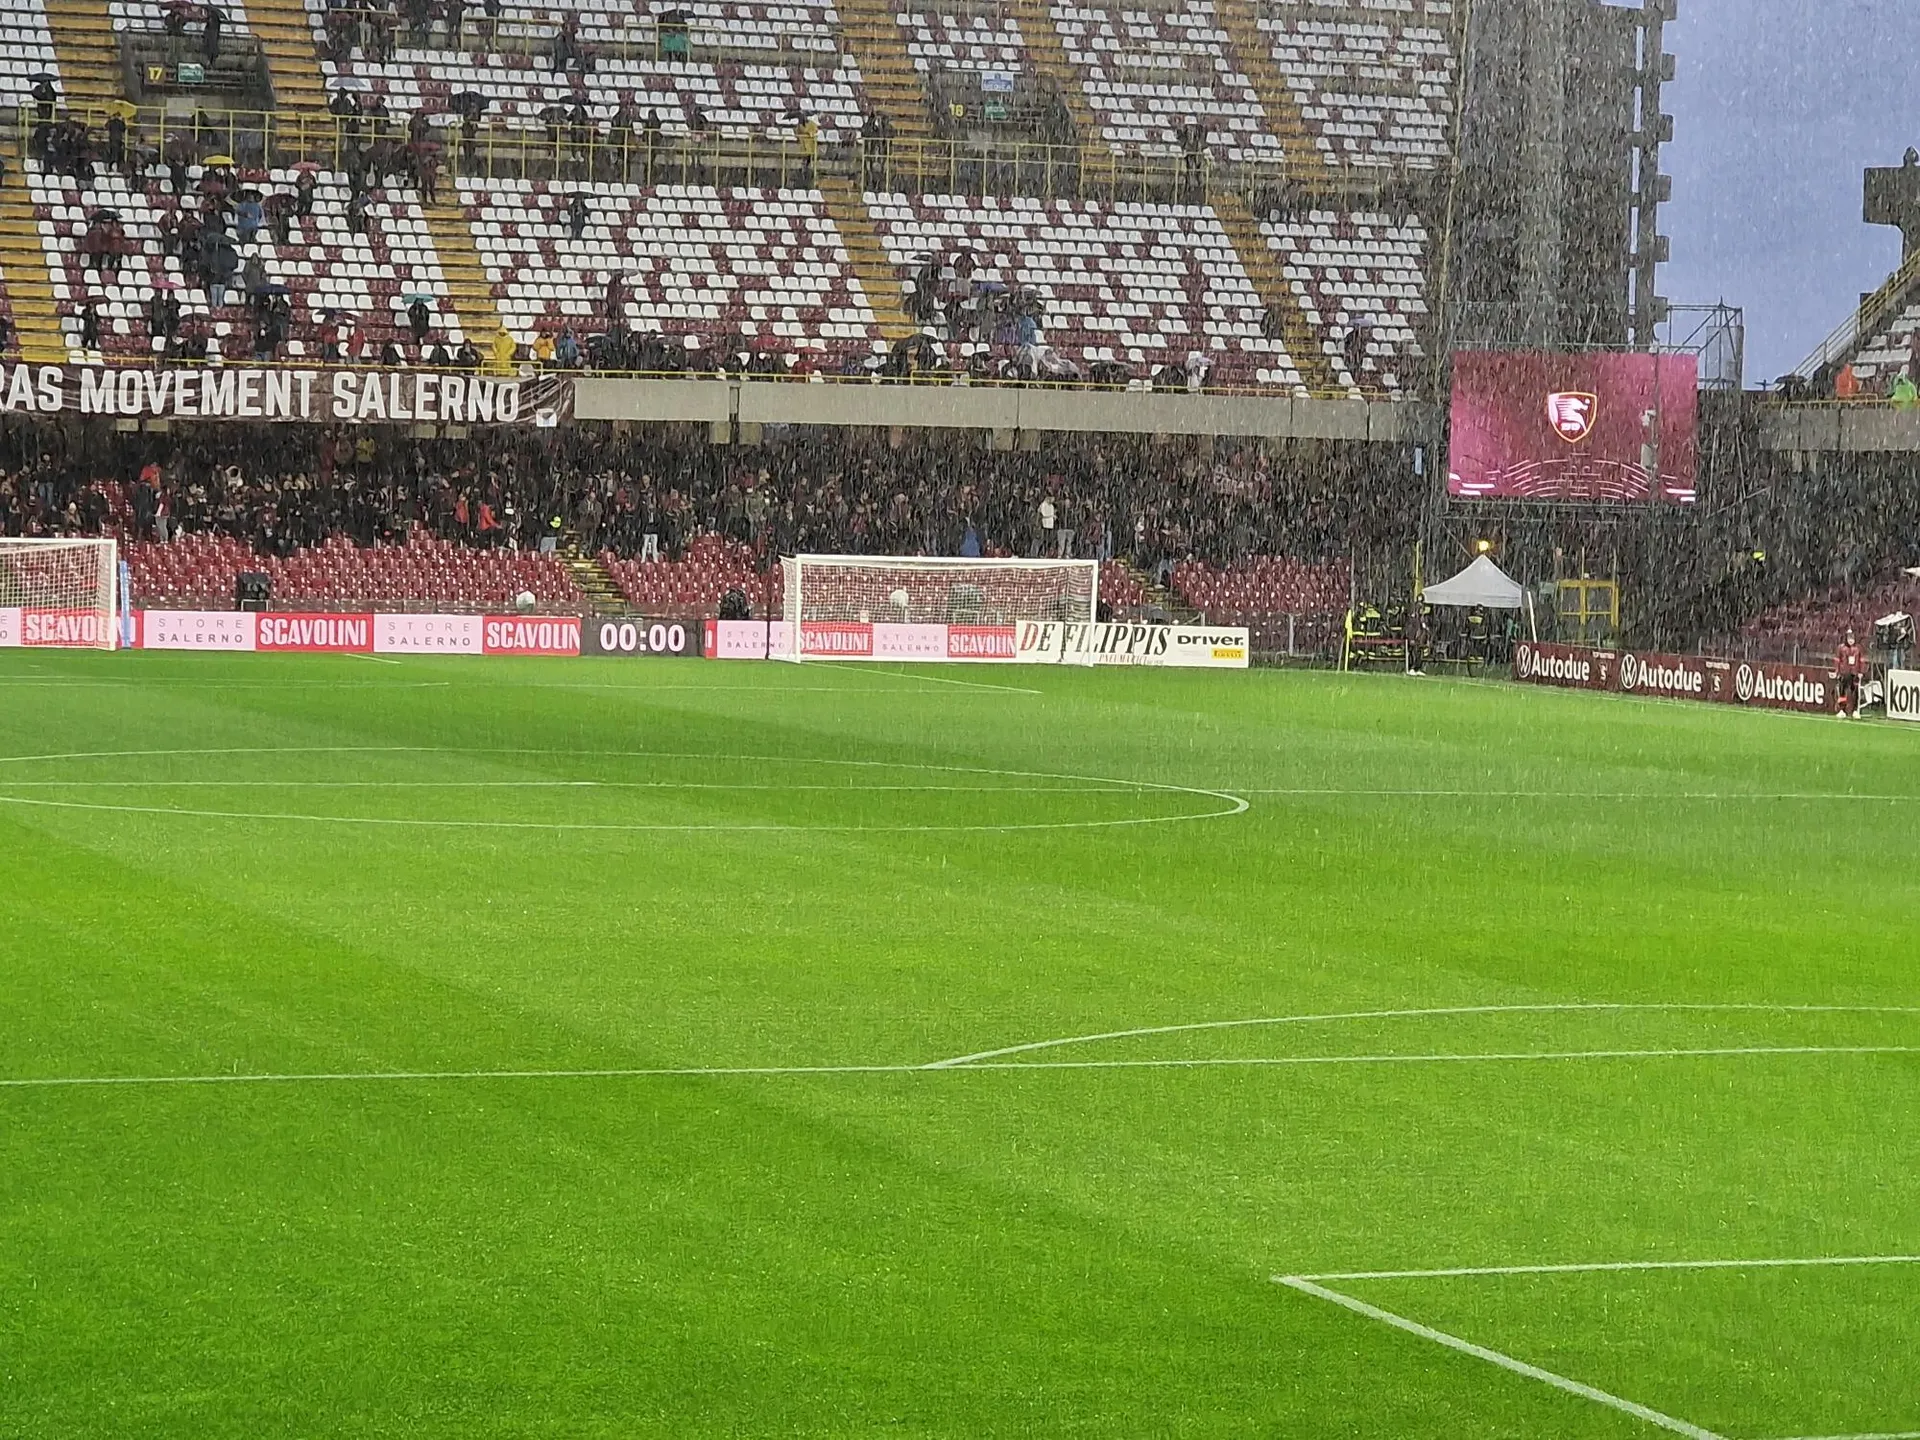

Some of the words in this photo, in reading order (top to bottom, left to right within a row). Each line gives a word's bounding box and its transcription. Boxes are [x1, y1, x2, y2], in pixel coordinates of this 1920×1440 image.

[148, 66, 163, 80] 17
[80, 367, 317, 418] MOVEMENT
[333, 371, 519, 422] SALERNO
[158, 618, 244, 629] STORE
[260, 618, 366, 646] SCAVOLINI
[388, 622, 470, 632] STORE
[600, 623, 685, 652] 00:00
[1019, 622, 1057, 652] DE
[158, 633, 243, 644] SALERNO
[388, 635, 470, 646] SALERNO
[1531, 651, 1590, 681] Autodue
[1637, 660, 1702, 692] Autodue
[1754, 671, 1825, 704] Autodue
